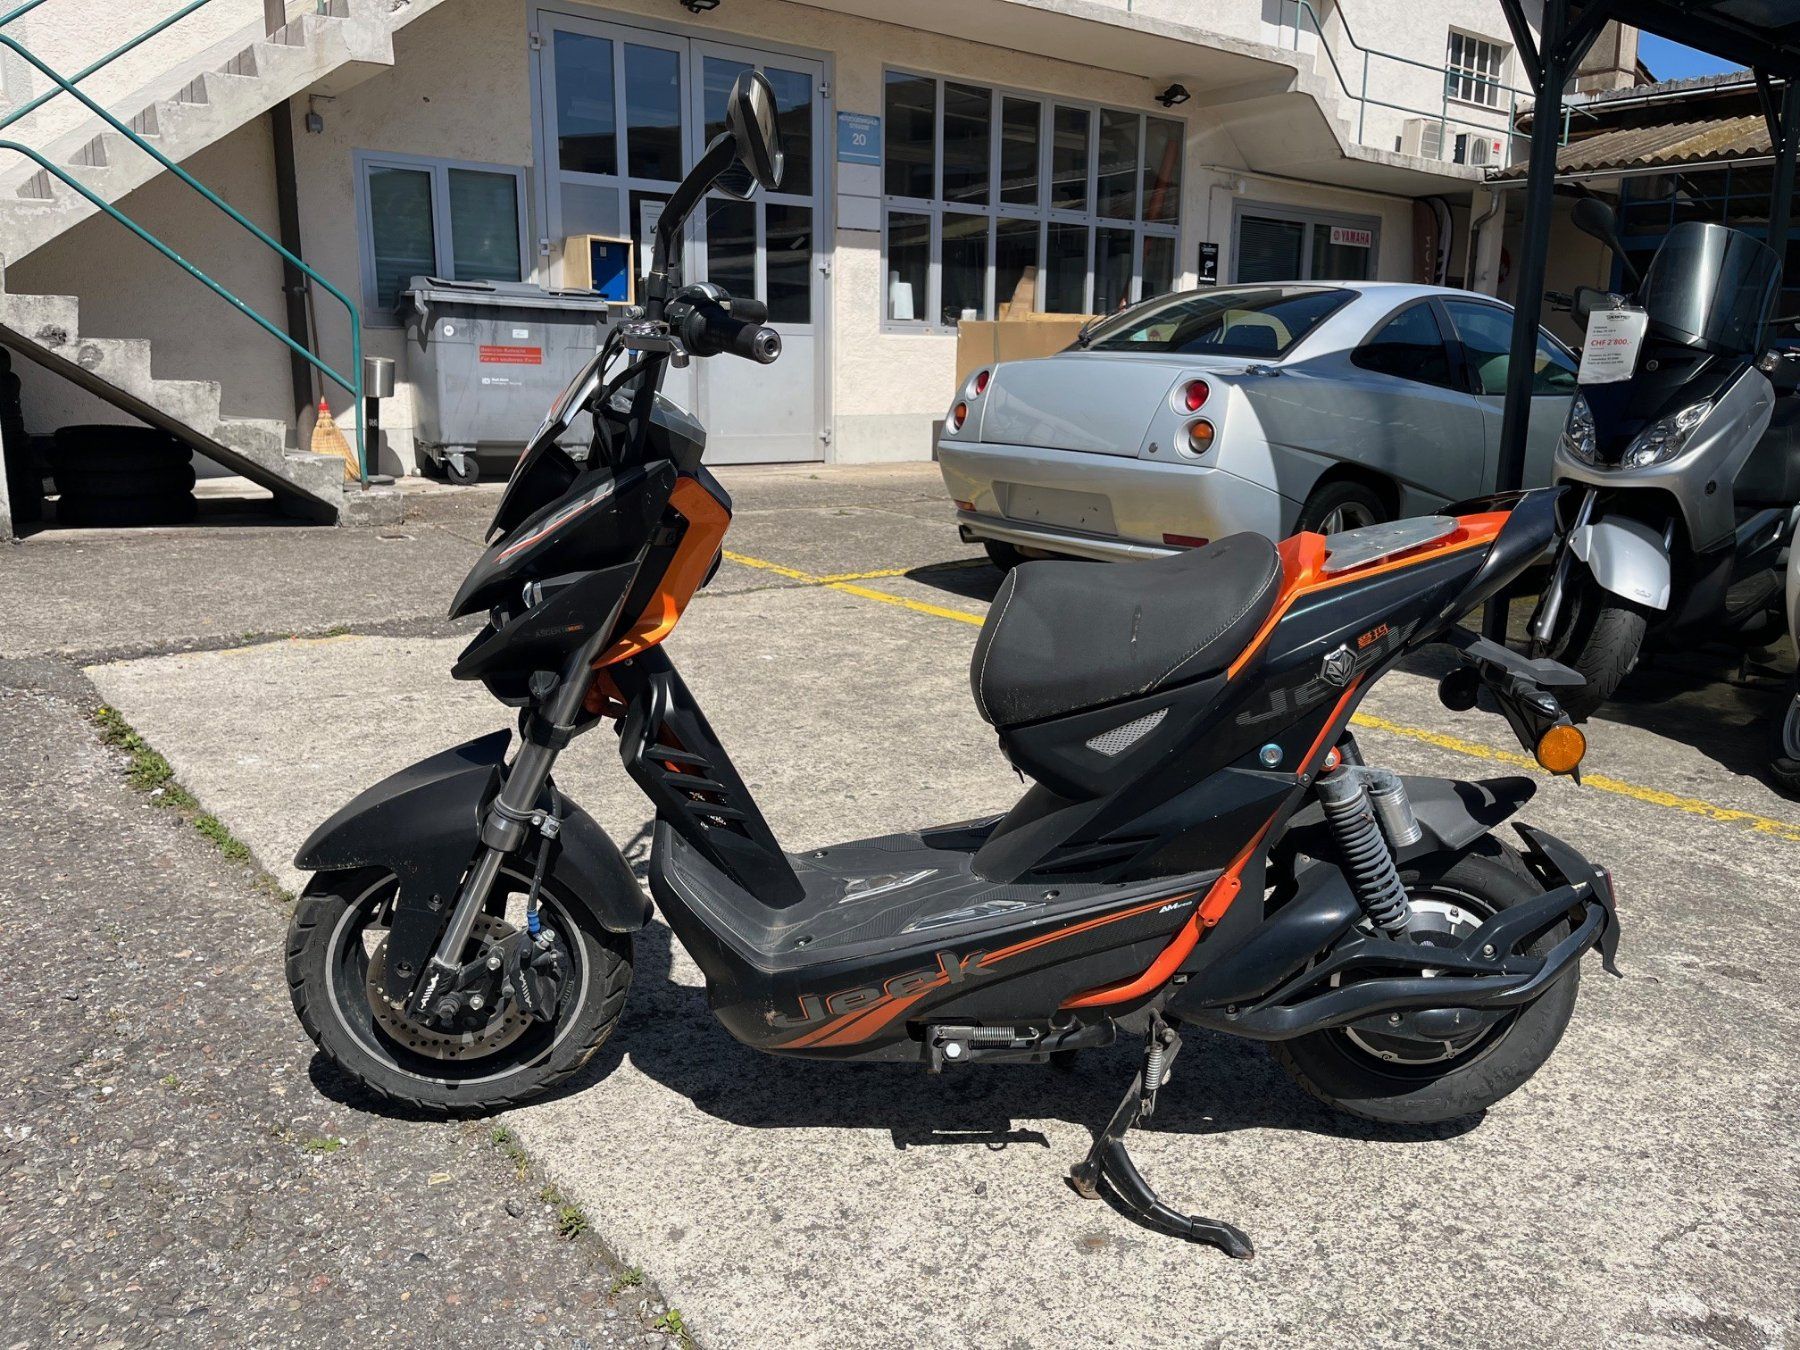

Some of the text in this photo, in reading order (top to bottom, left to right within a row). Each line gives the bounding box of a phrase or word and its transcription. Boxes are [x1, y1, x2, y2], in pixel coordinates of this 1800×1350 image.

[853, 133, 866, 146] 20
[1341, 230, 1369, 245] YAMAHA
[772, 949, 997, 1029] Jeek
